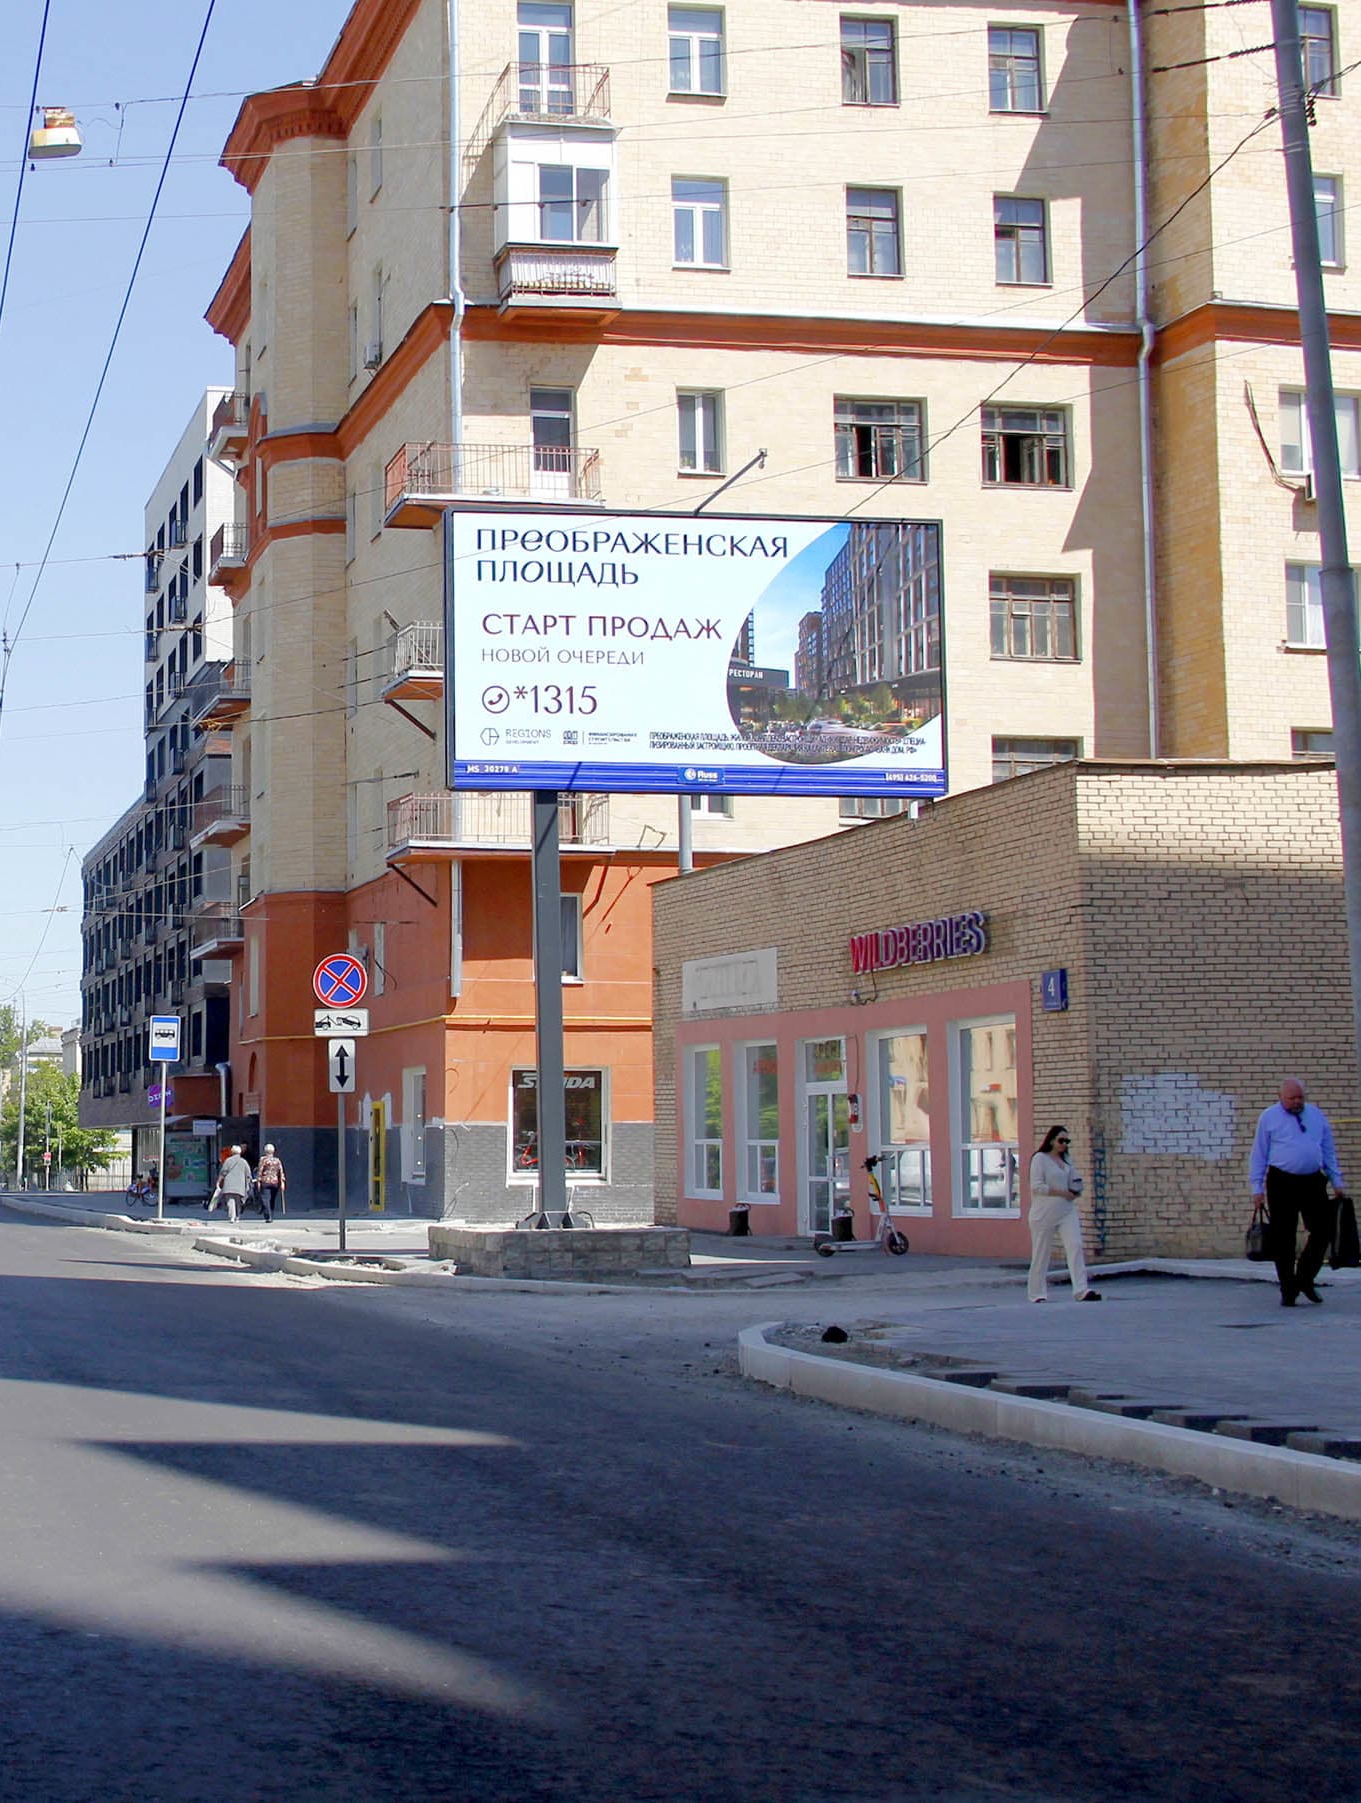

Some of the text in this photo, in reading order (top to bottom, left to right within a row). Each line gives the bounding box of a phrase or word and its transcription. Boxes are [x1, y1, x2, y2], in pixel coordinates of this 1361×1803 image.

[477, 559, 639, 588] ПЛОЩАДЬ
[482, 613, 722, 640] СТАРТ ПРОДАЖ
[481, 646, 644, 665] НОВОЙ ОЧЕРЕДИ
[728, 668, 764, 680] РЕСТОРАН
[505, 728, 552, 739] REGIONS
[697, 770, 718, 779] Russ
[850, 911, 986, 976] WILDBERRIES
[1047, 976, 1055, 997] 4
